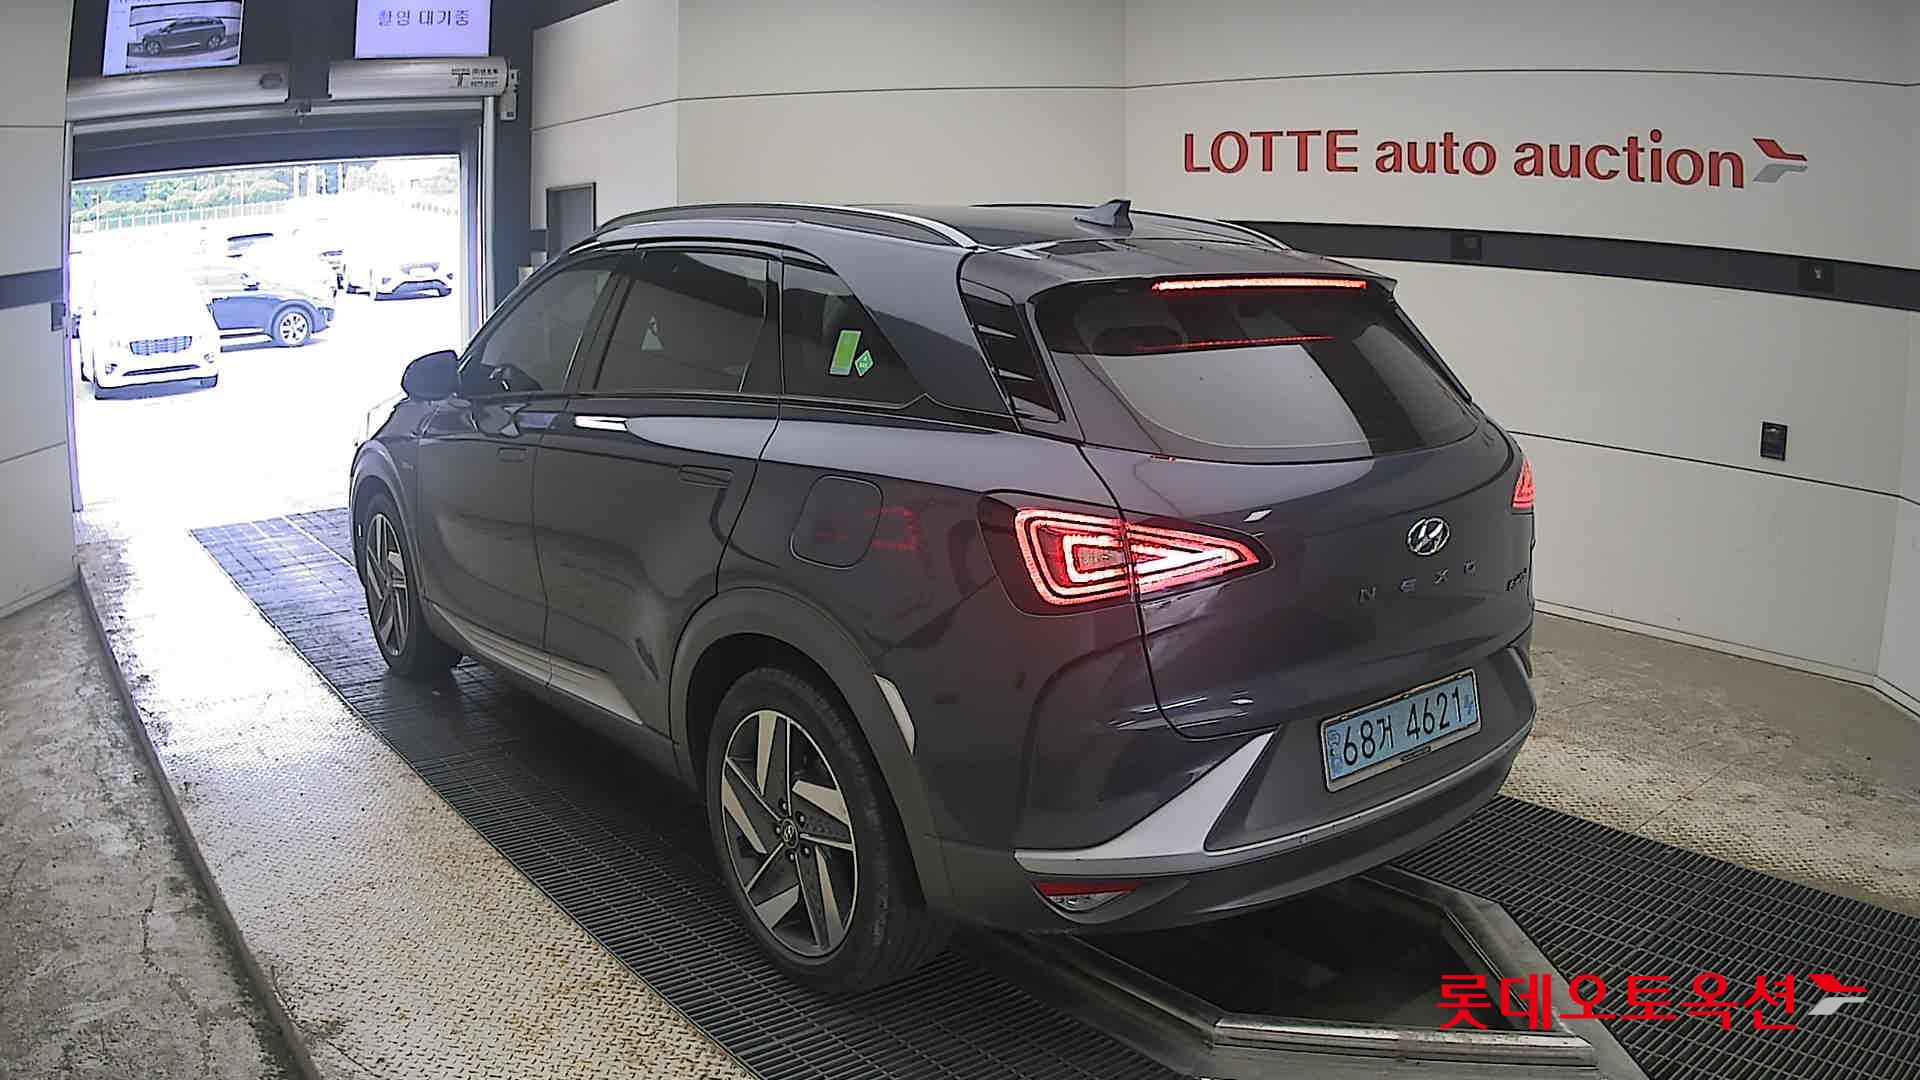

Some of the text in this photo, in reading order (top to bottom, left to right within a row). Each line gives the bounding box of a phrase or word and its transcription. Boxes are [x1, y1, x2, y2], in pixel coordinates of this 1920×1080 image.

[418, 9, 472, 28] 대기중
[1184, 129, 1745, 189] LOTTE auto auction
[1359, 560, 1476, 603] NEXO
[1342, 686, 1463, 767] 68거 4621
